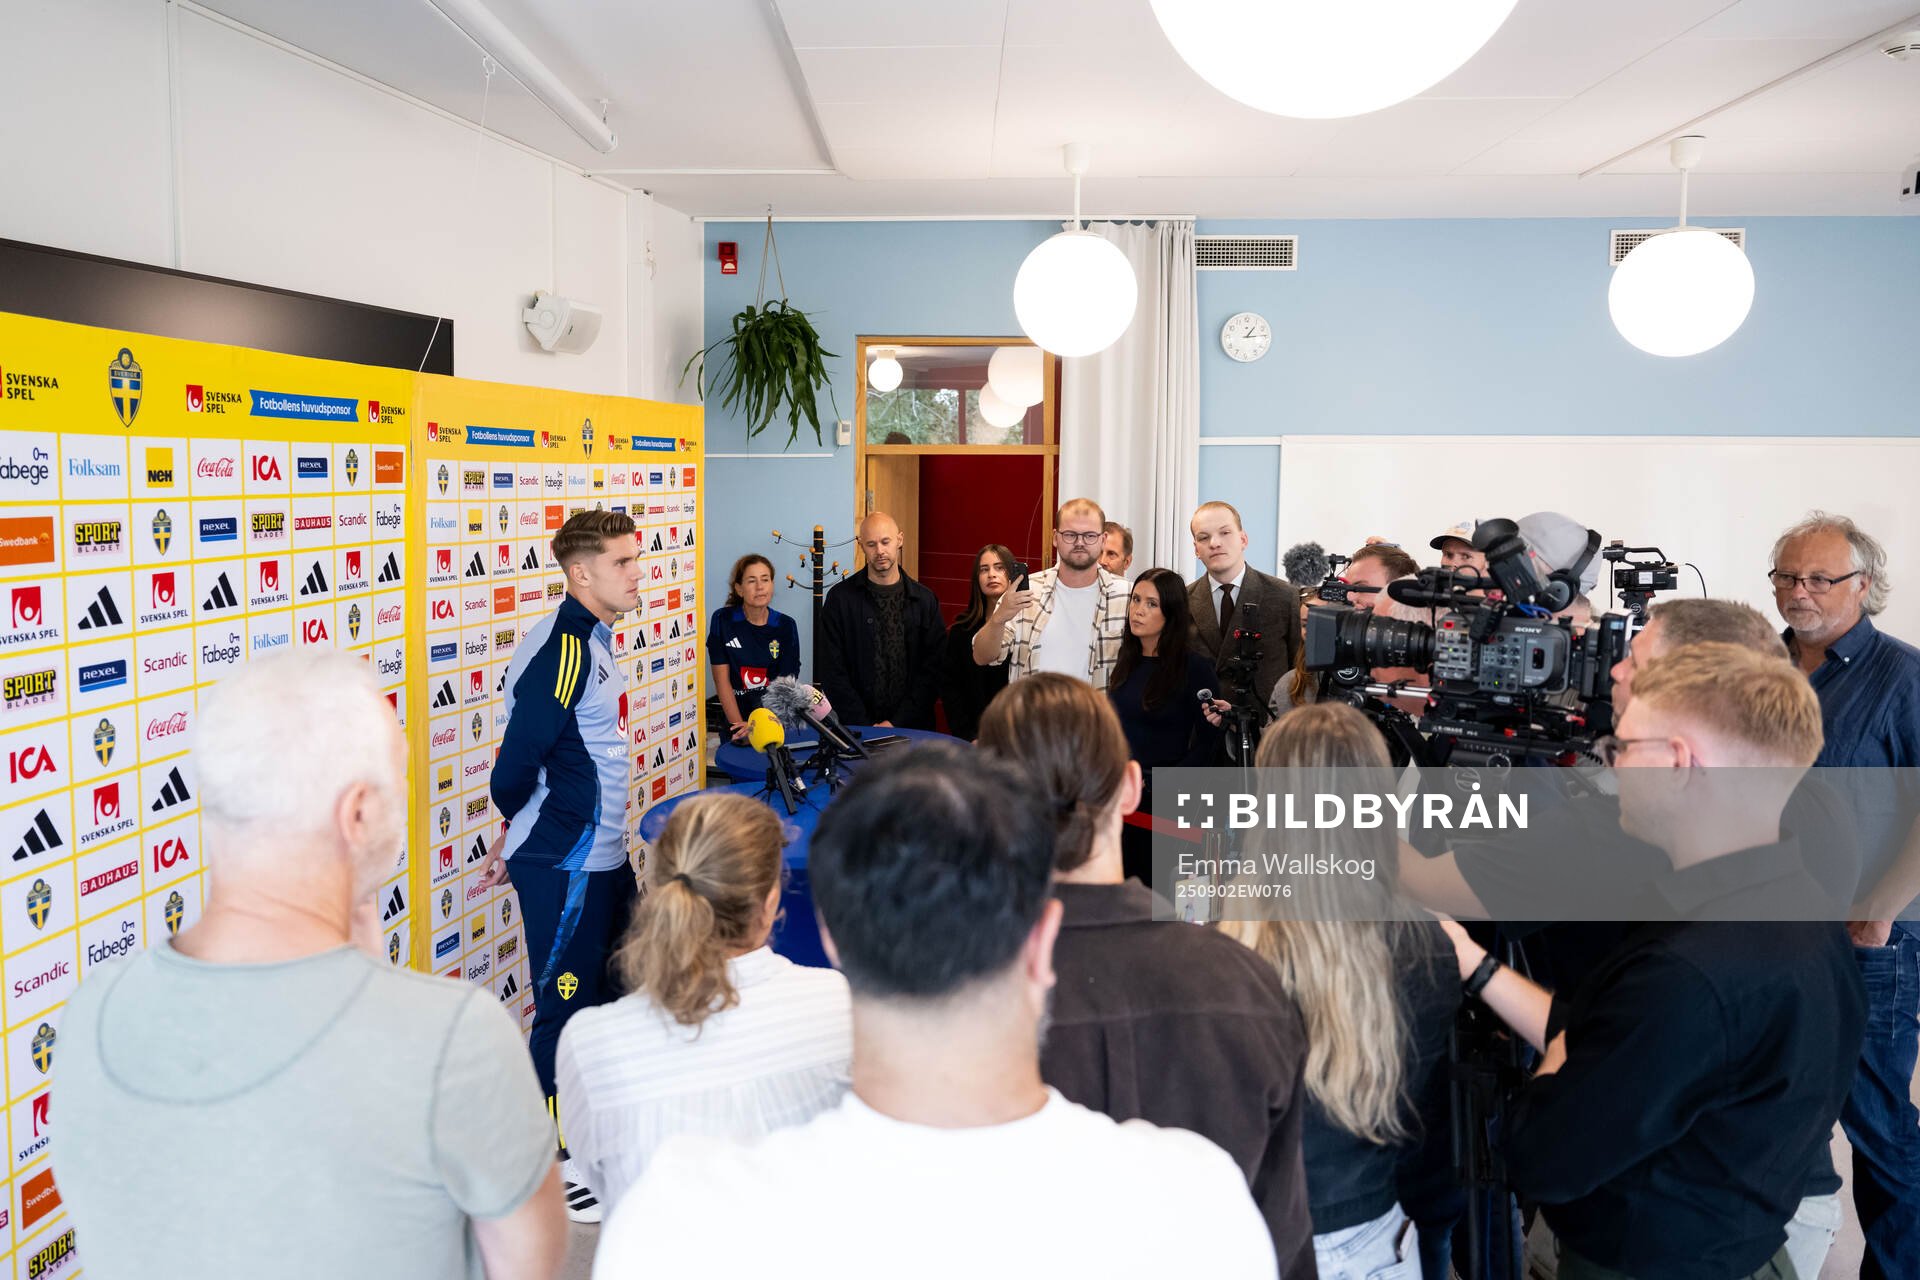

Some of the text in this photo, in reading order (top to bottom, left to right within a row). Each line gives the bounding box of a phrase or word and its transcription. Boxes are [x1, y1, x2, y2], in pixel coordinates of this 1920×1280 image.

[6, 372, 59, 389] SVENSKA
[6, 388, 36, 400] SPEL
[206, 392, 242, 403] SVENSKA
[206, 403, 226, 414] SPEL
[260, 397, 351, 416] Fotbollens huvudsponsor
[381, 416, 394, 424] SPEL
[439, 426, 462, 436] SVENSKA
[0, 456, 48, 486] abege
[68, 458, 120, 477] Folksam
[252, 455, 282, 481] ICA
[520, 476, 538, 486] Scandic
[632, 472, 644, 486] ICA
[252, 512, 284, 532] SPORT
[295, 516, 331, 530] BAUHAUS
[339, 513, 367, 527] Scandic
[376, 511, 400, 529] Fabege
[430, 517, 456, 529] Folksam
[74, 522, 122, 545] SPORT
[78, 544, 120, 553] BLADET
[652, 566, 663, 580] ICA
[338, 583, 358, 592] SVENSKA
[250, 594, 288, 606] SVENSKA SPEL
[464, 599, 487, 611] Scandic
[141, 609, 188, 624] SVENSKA SPEL
[432, 600, 455, 620] ICA
[40, 628, 59, 639] SPEL
[303, 618, 328, 645] ICA
[253, 632, 289, 650] Folksam
[465, 641, 488, 655] Fabege
[144, 652, 187, 673] Scandic
[202, 645, 240, 664] Fabege
[685, 647, 696, 662] ICA
[3, 670, 56, 701] SPORT
[7, 693, 55, 709] BLADET
[634, 728, 646, 745] ICA
[10, 744, 57, 784] ICA
[465, 760, 490, 776] Scandic
[467, 796, 488, 816] SPORT
[80, 819, 134, 844] SVENSKA SPEL
[154, 836, 190, 873] ICA
[81, 862, 138, 895] BAUHAUS
[88, 933, 135, 967] Fabege
[14, 961, 69, 998] Scandic
[468, 961, 490, 981] Fabege
[29, 1228, 76, 1280] SPORT
